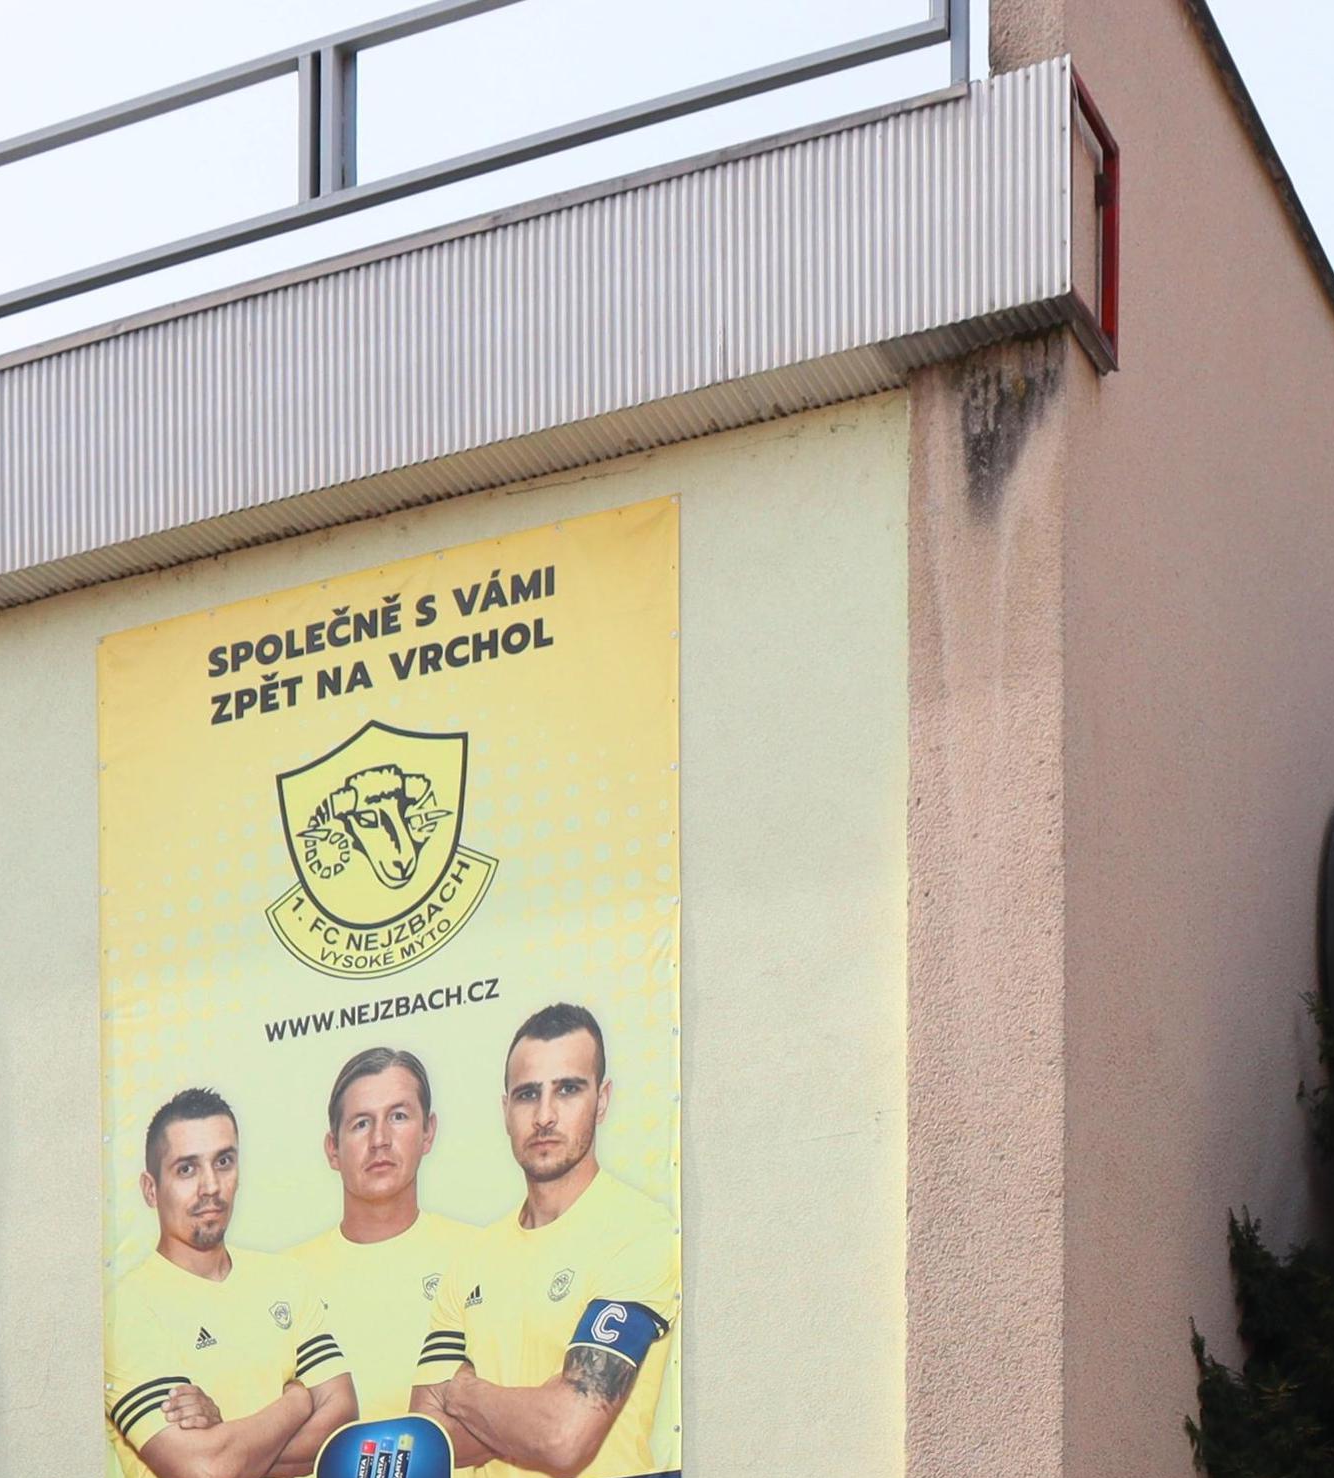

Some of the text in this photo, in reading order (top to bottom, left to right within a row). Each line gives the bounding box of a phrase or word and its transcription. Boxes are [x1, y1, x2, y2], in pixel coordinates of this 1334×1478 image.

[207, 565, 556, 679] SPOLEČNĚ S VÁMI
[210, 617, 554, 725] ZPĚT NA VRCHOL
[291, 860, 471, 951] 1. FC NEJZBACH
[319, 918, 452, 969] VYSOKÉ MÝTO
[265, 978, 499, 1042] WWW.NEJZBACH.CZ
[591, 1303, 627, 1343] C
